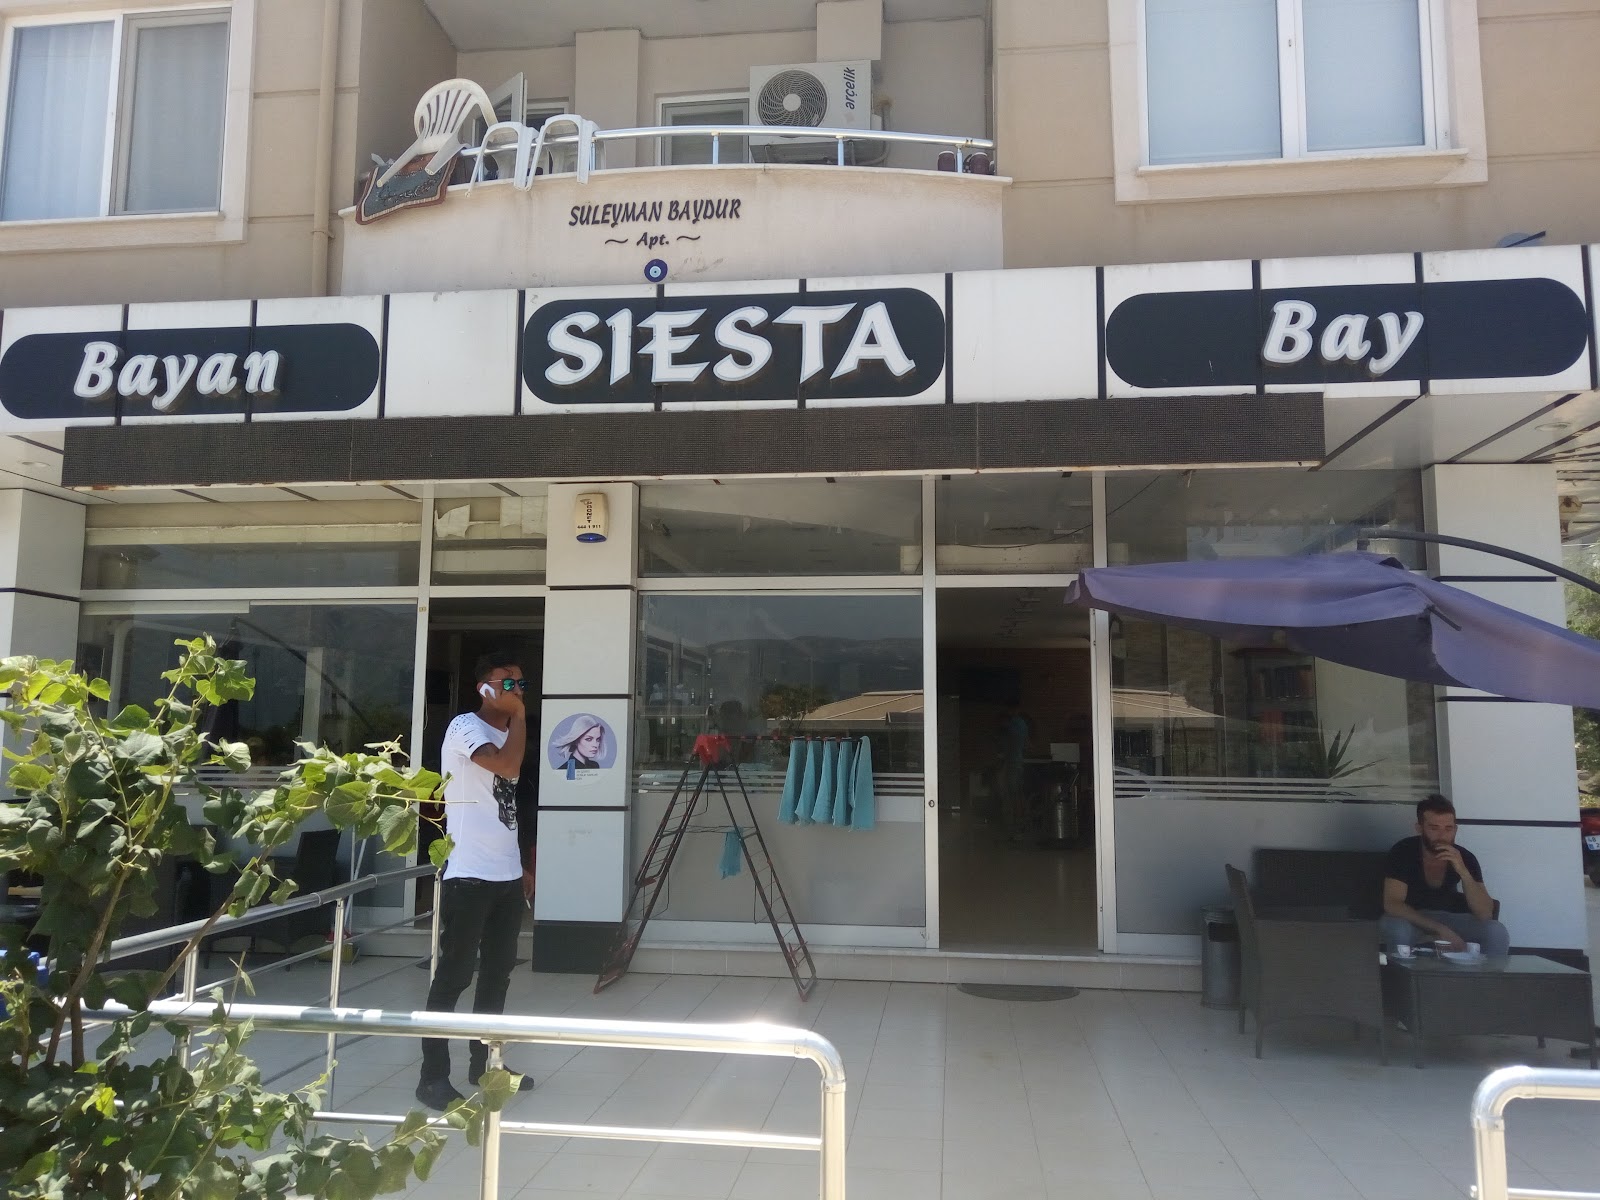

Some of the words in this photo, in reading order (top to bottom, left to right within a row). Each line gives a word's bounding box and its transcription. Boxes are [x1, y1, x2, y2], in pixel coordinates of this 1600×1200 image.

[843, 66, 858, 110] arçelik
[667, 198, 742, 225] BAYDUR
[636, 232, 670, 250] Apt.
[543, 300, 917, 387] SIESTA
[1262, 299, 1425, 375] Bay
[73, 340, 280, 412] Bayan
